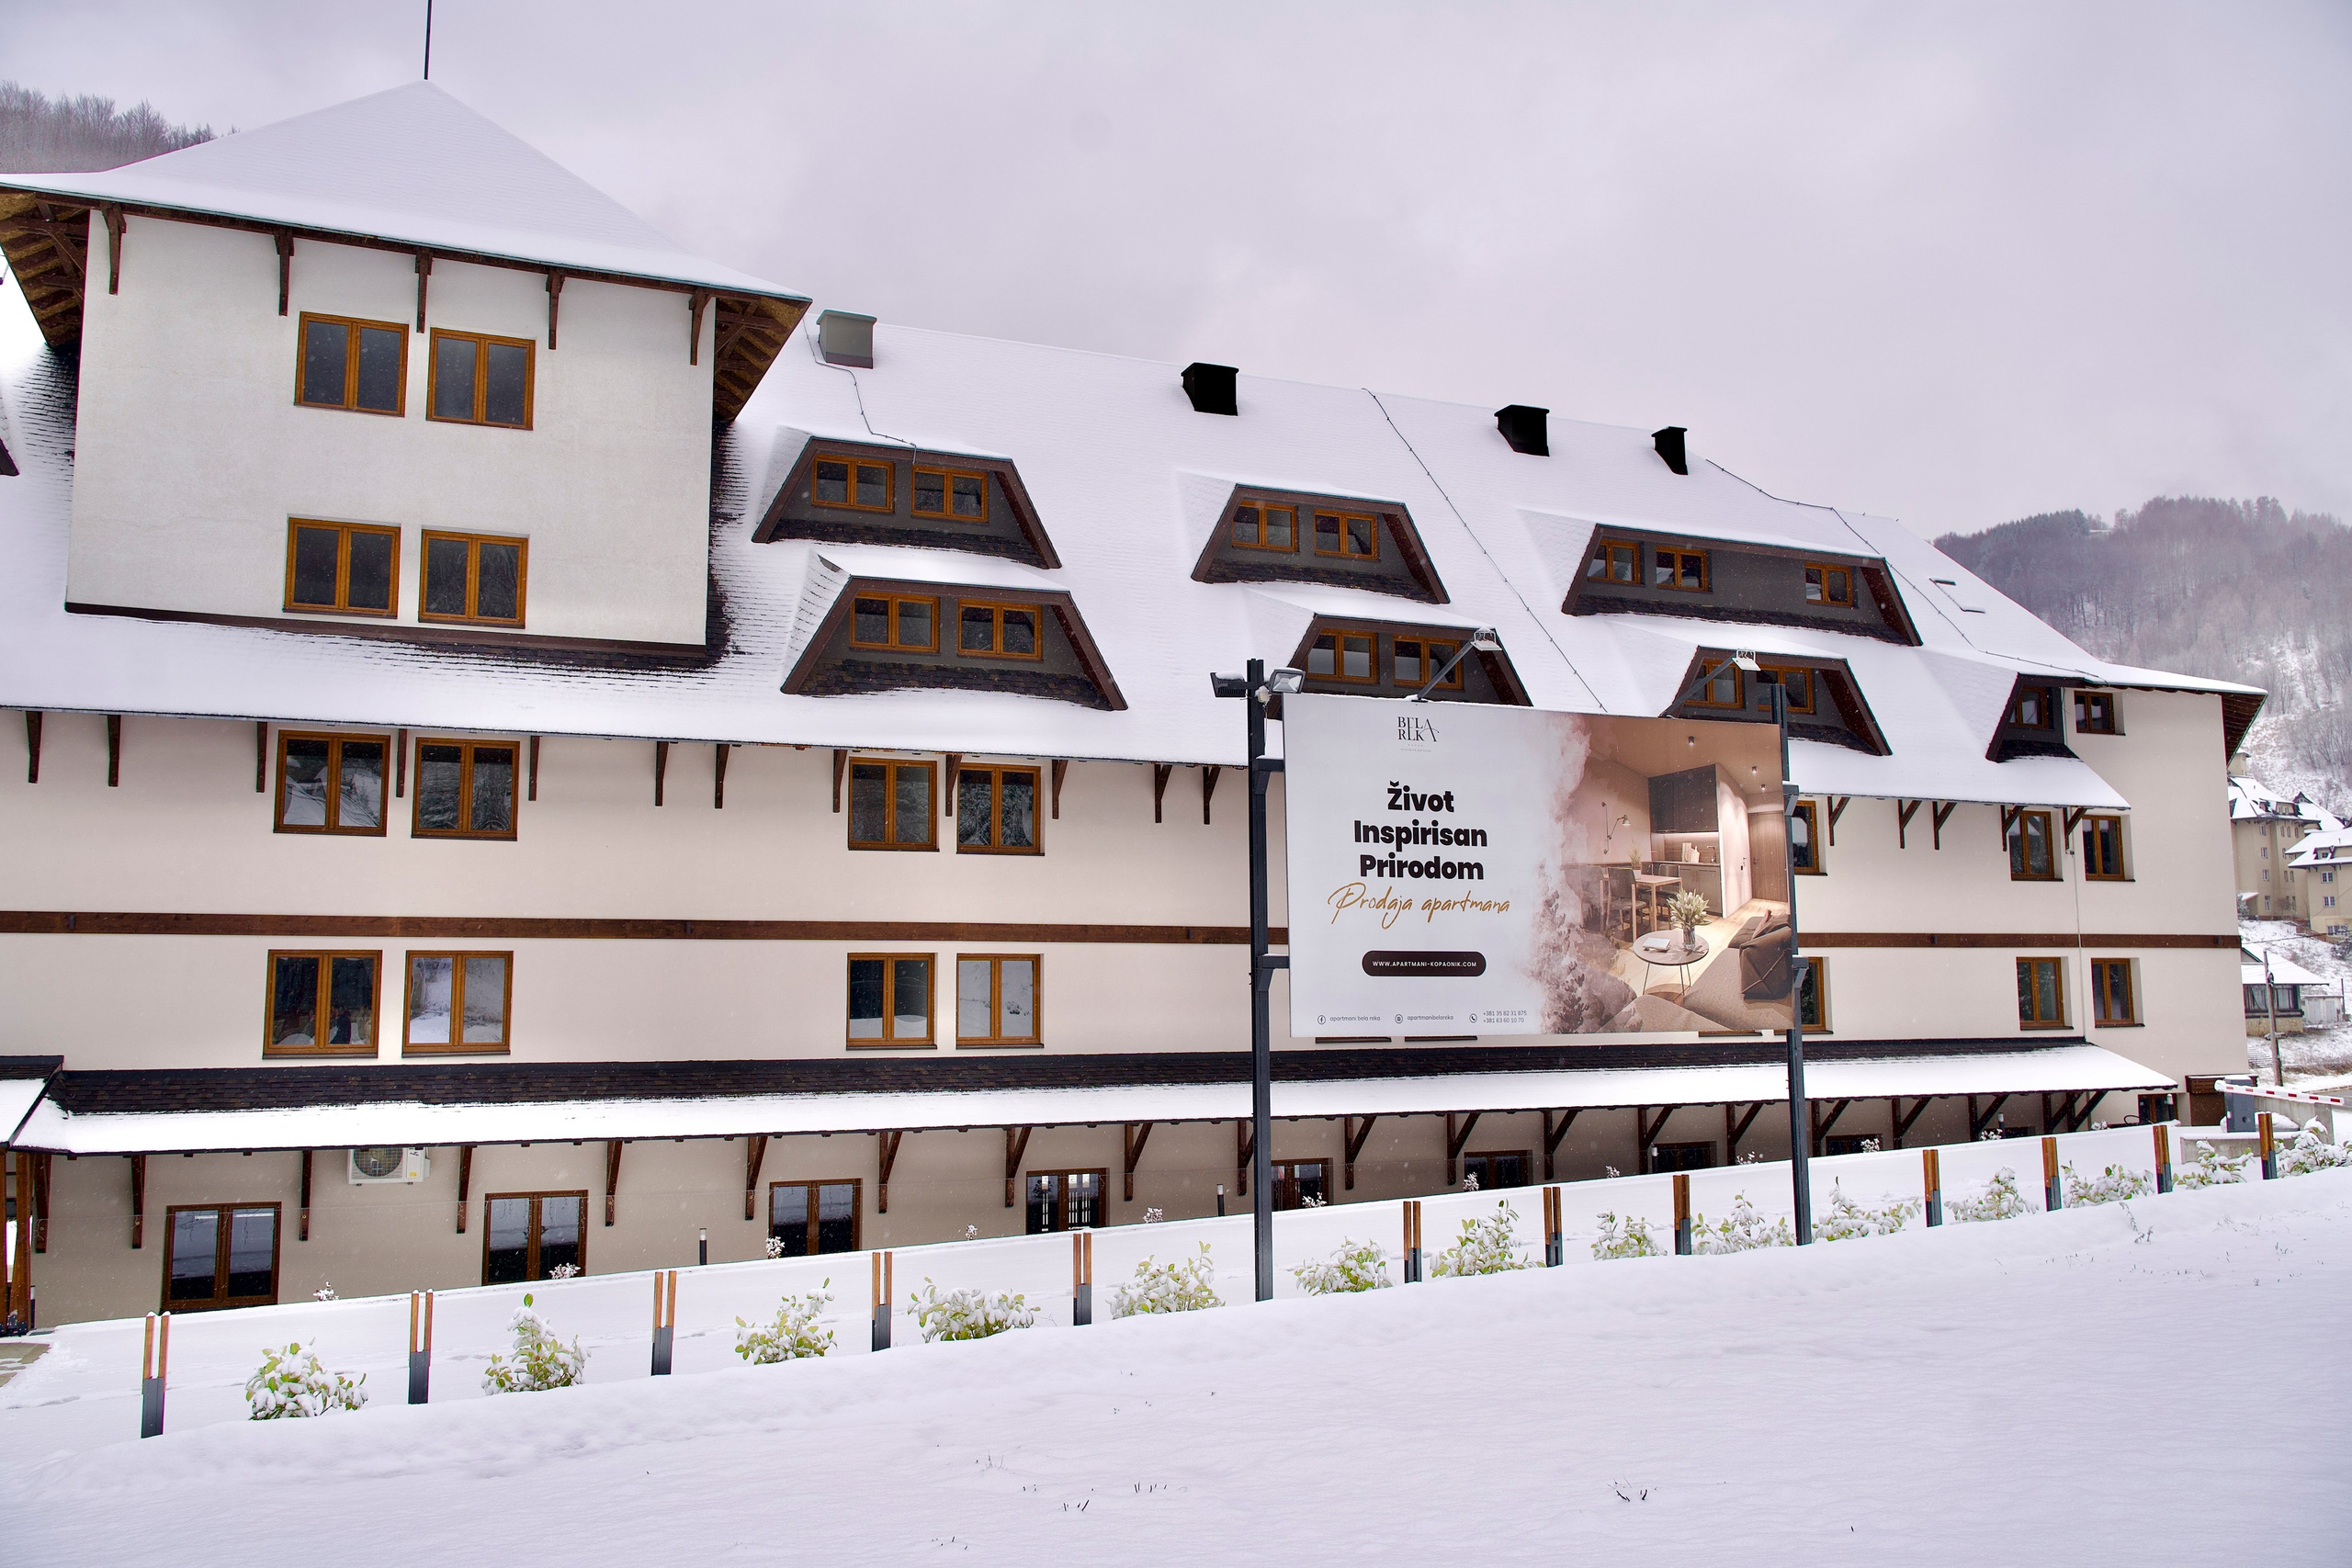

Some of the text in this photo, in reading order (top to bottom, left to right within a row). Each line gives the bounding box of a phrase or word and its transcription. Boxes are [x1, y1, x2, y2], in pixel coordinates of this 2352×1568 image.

[1386, 780, 1455, 813] Život
[1353, 818, 1488, 852] Inspirisan
[1360, 852, 1485, 880] Prirodom
[1327, 882, 1510, 931] Prodaja apartmana
